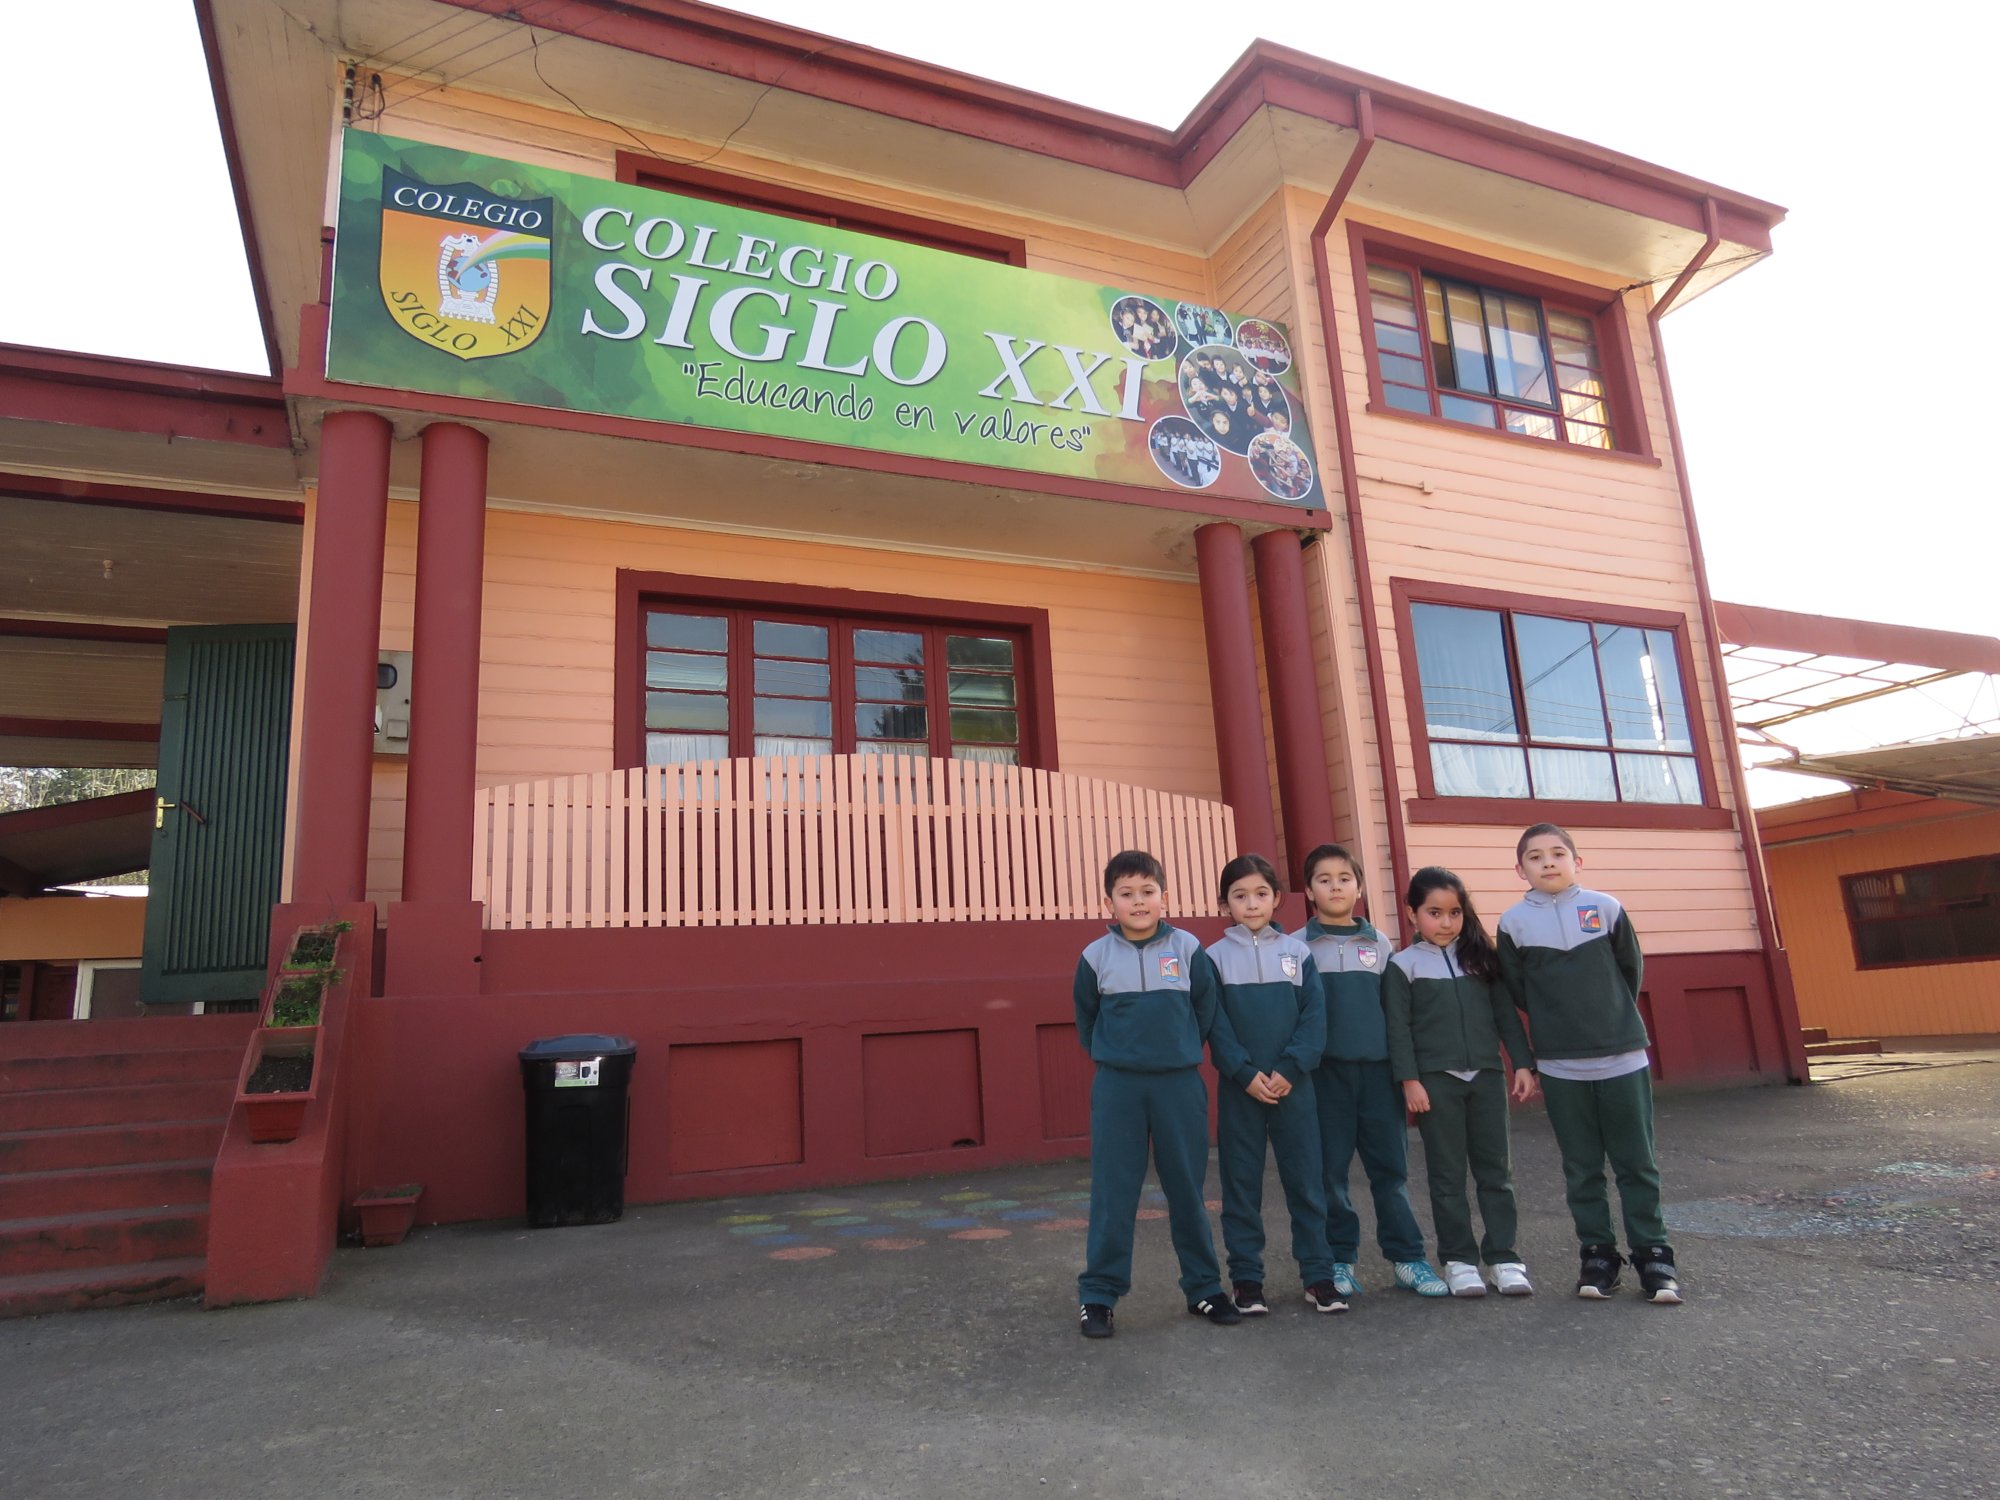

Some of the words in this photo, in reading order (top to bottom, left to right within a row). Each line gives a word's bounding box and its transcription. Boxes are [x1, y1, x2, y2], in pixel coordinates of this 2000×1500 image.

[393, 186, 543, 230] COLEGIO
[582, 207, 898, 300] COLEGIO
[390, 290, 478, 351] SIGLO
[498, 304, 541, 346] XXI
[581, 263, 947, 386] SIGLO
[978, 332, 1148, 422] XXI
[682, 361, 874, 422] "Educando
[895, 401, 936, 432] en
[953, 407, 1092, 452] valores"
